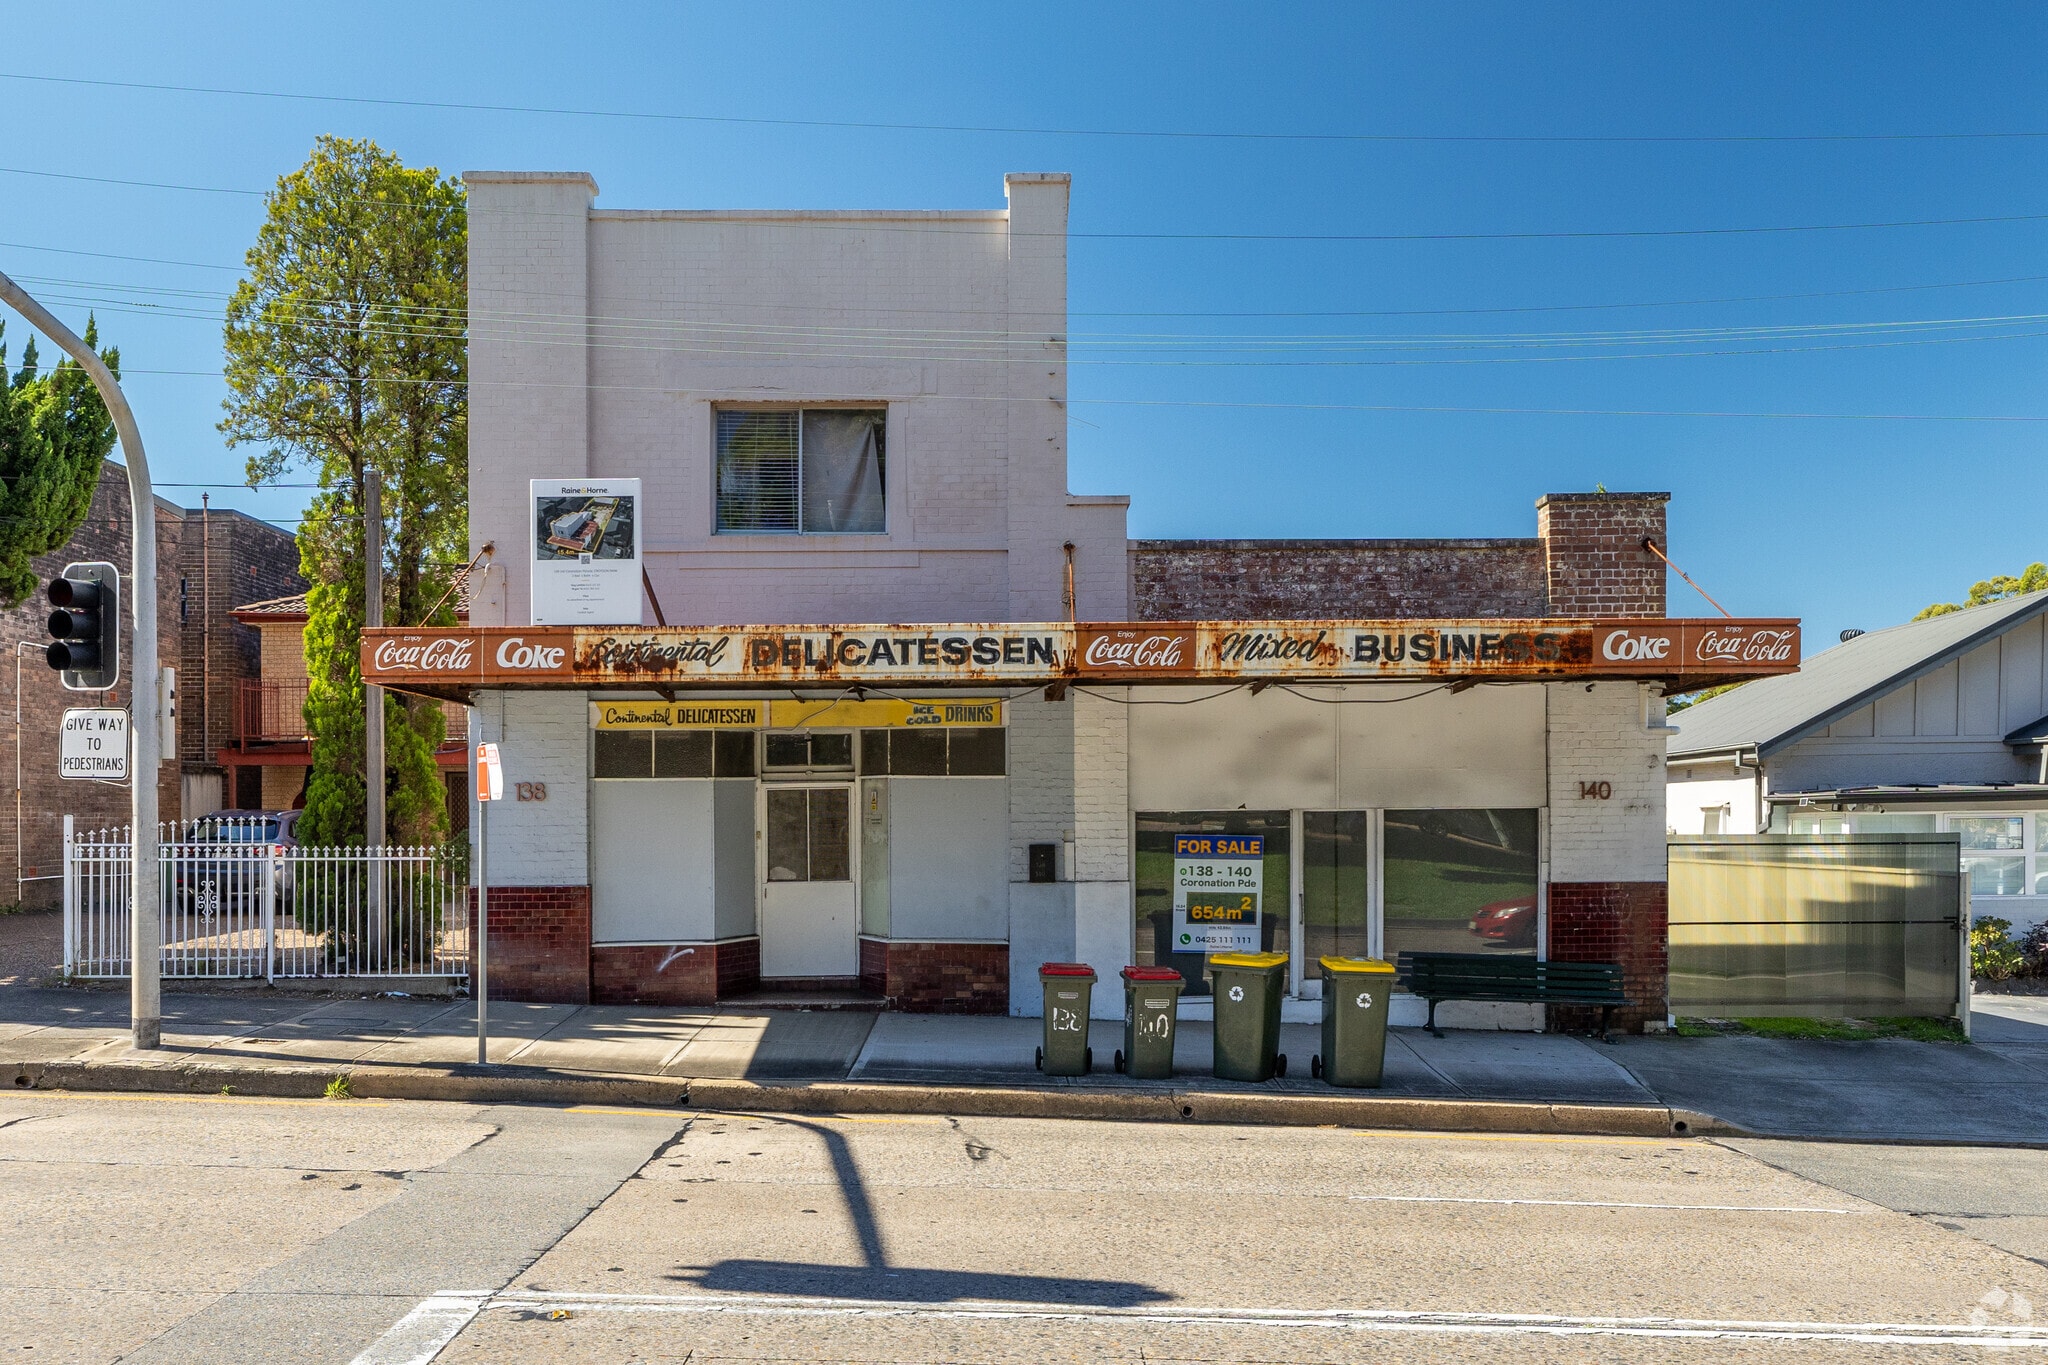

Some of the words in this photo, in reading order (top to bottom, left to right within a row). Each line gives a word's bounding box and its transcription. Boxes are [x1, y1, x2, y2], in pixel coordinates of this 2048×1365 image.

[1117, 630, 1136, 639] Enjoy
[1724, 625, 1744, 634] Enjoy
[374, 638, 476, 670] Coca-Cola
[496, 637, 566, 669] Coke
[589, 635, 730, 668] Continental
[751, 636, 1053, 667] DELICATESSEN
[1085, 635, 1189, 667] Coca-Cola
[1221, 630, 1327, 663] Mixed
[1353, 633, 1561, 663] BUSINESS
[1602, 630, 1671, 661] Coke
[1696, 630, 1796, 662] Coca-Cola
[606, 707, 673, 726] Continental
[677, 708, 756, 724] DELICATESSEN
[945, 704, 994, 722] DRINKS
[66, 718, 93, 731] GIVE
[98, 718, 124, 731] WAY
[87, 737, 102, 751] TO
[63, 757, 124, 771] PEDESTRIANS
[515, 782, 547, 801] 138
[1579, 781, 1612, 800] 140
[1177, 840, 1212, 854] FOR
[1217, 840, 1261, 855] SALE
[1188, 866, 1213, 876] 138
[1227, 866, 1252, 877] 140
[1180, 878, 1235, 888] Coronation
[1238, 879, 1257, 888] Pde
[1195, 936, 1217, 944] 0425
[1219, 936, 1233, 944] 111
